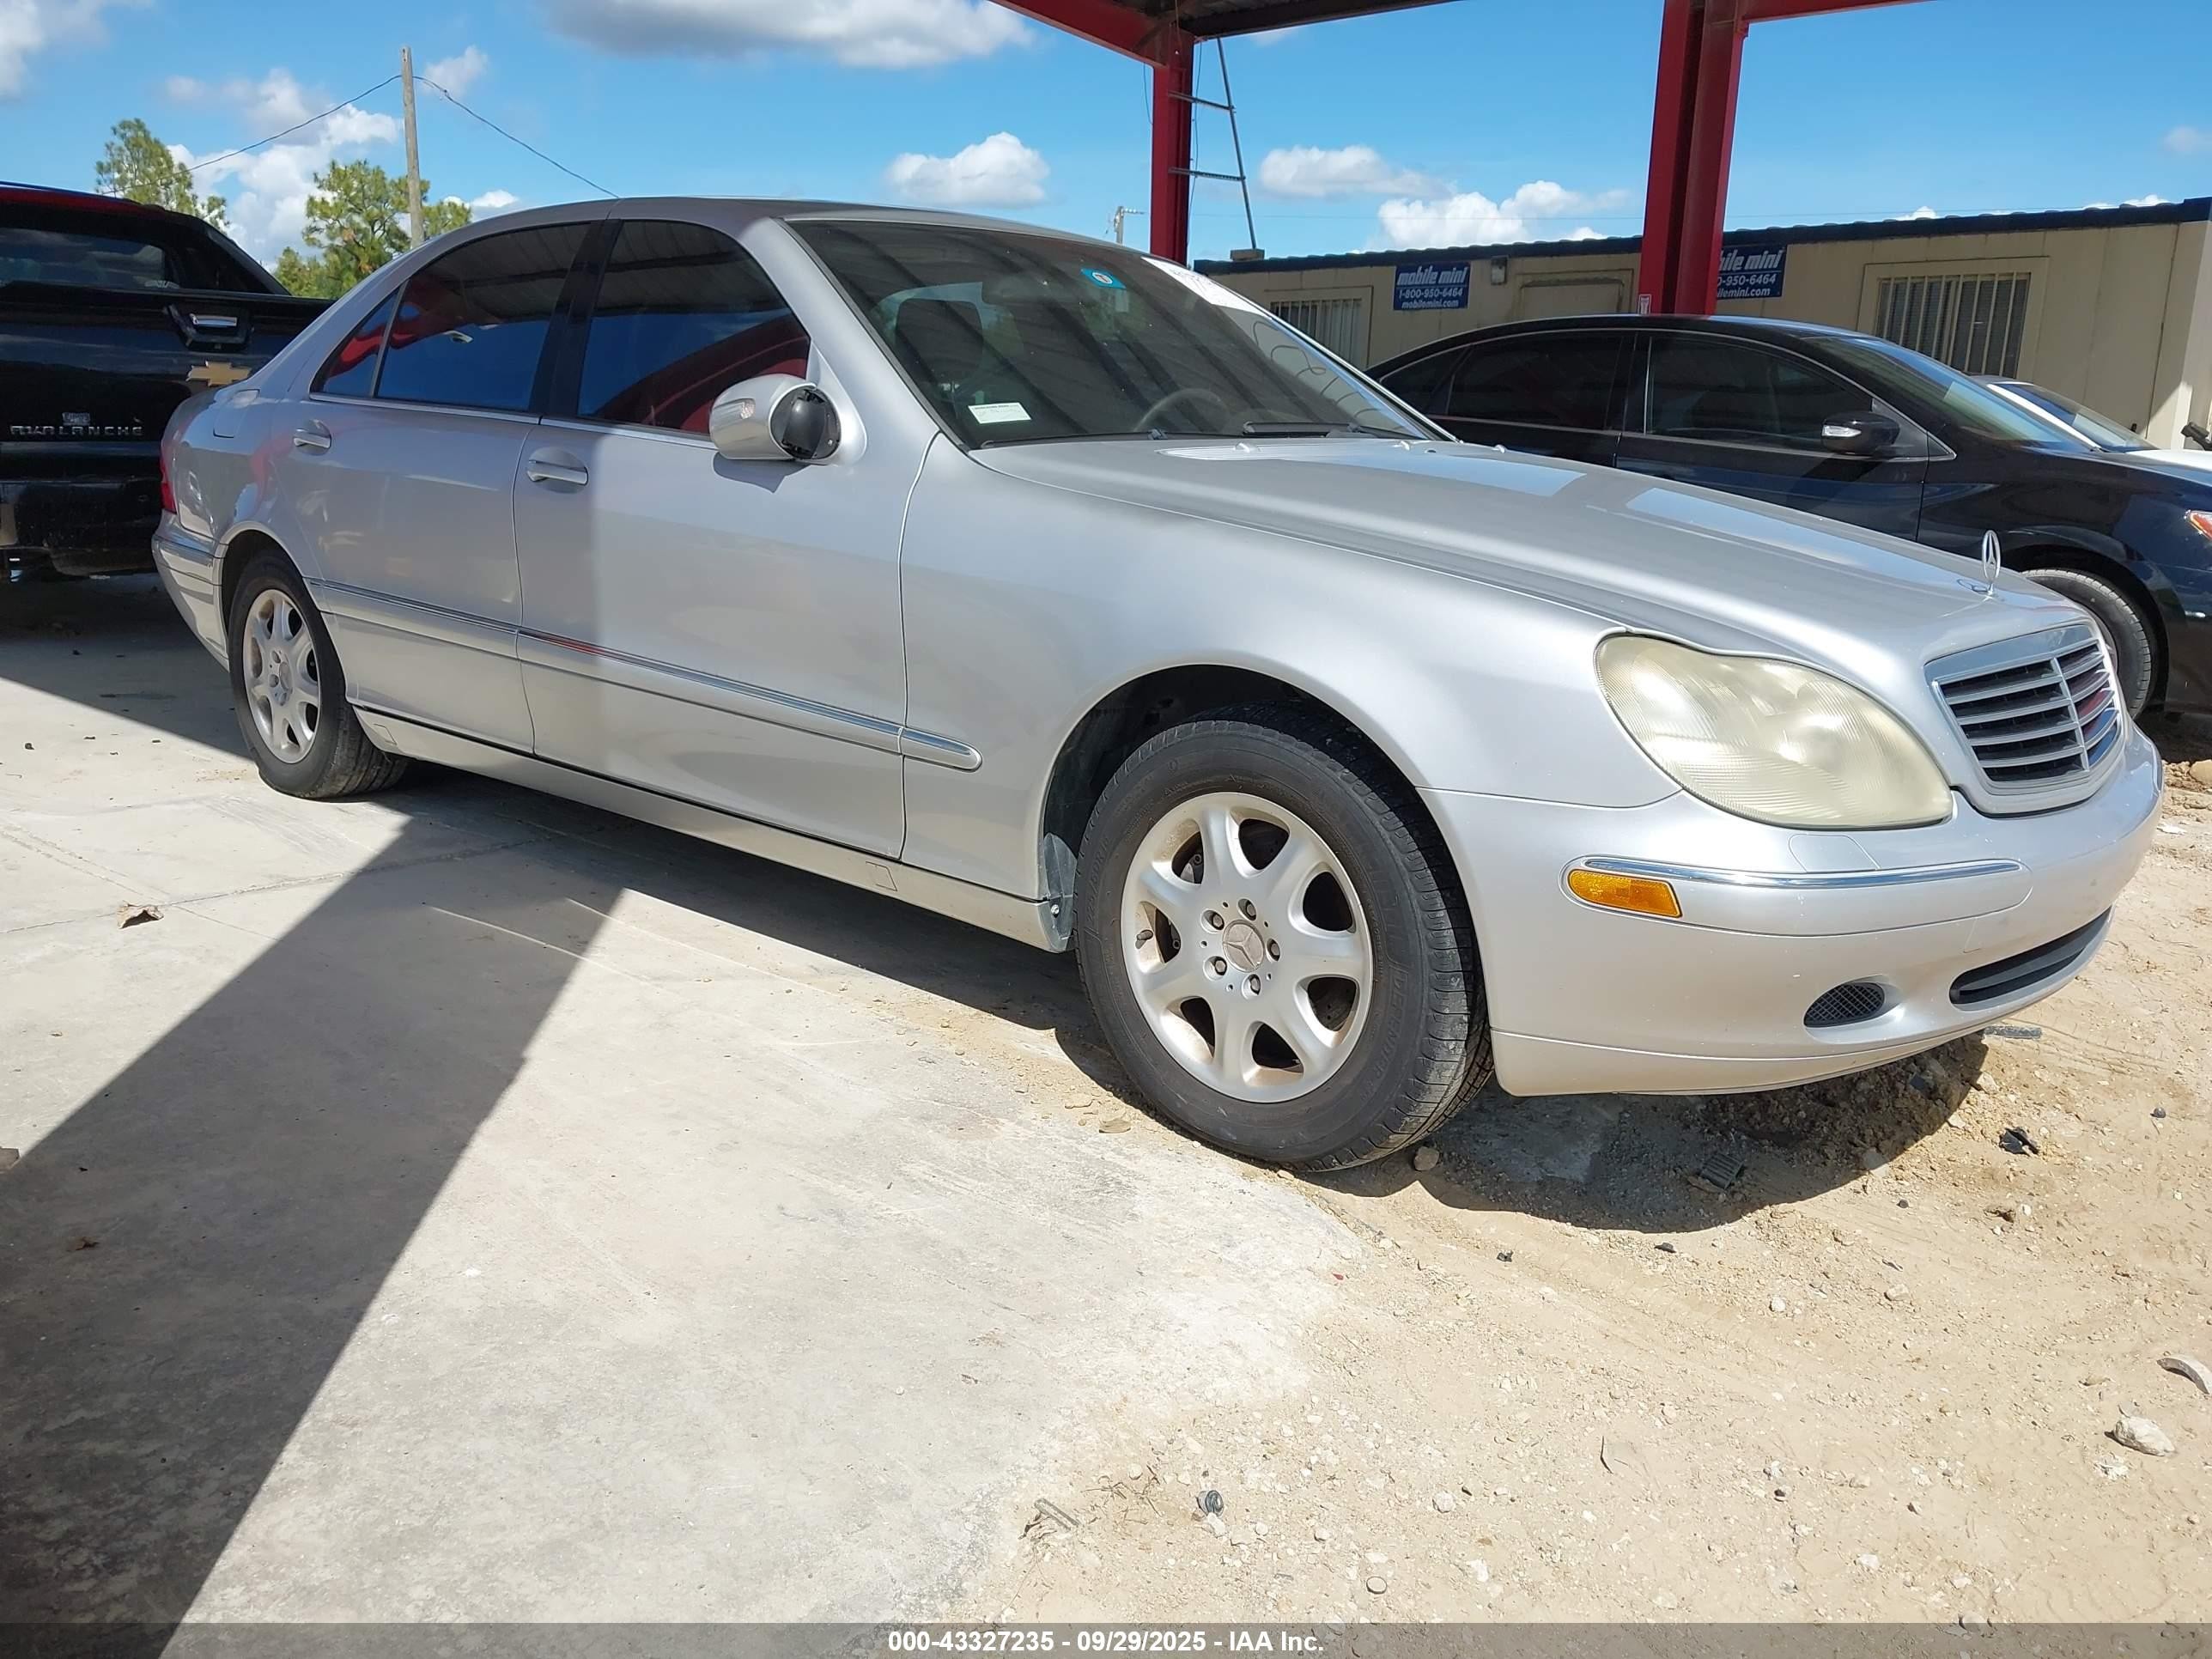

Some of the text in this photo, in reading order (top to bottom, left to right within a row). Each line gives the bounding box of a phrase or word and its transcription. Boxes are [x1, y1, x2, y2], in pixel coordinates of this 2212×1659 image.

[1744, 250, 1784, 270] mini
[1397, 264, 1468, 285] mobile mini
[1399, 287, 1463, 299] 1-800-950-6464
[1401, 299, 1459, 309] mobilemini.com
[9, 425, 144, 436] AVALANCHE
